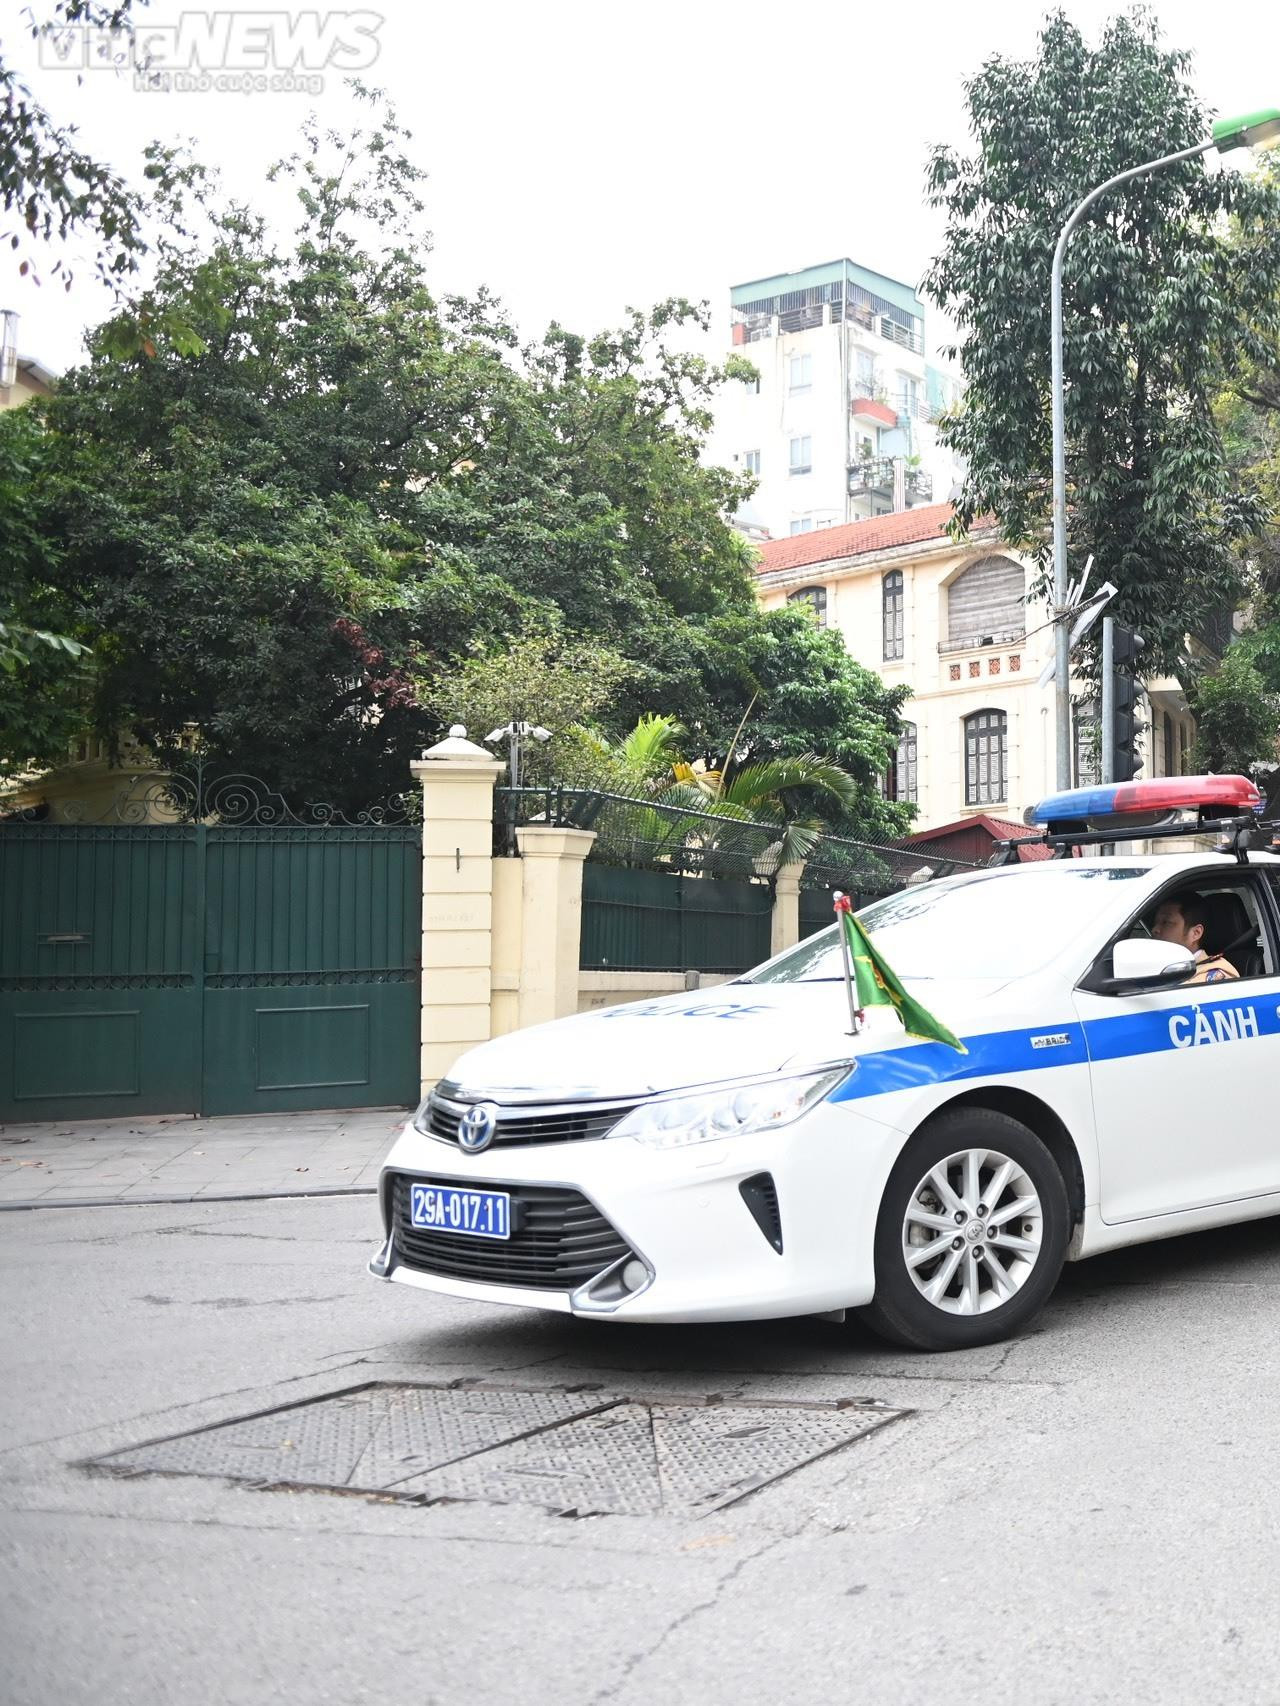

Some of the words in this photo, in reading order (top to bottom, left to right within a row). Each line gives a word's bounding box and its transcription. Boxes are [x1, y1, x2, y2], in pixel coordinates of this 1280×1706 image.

[588, 1003, 778, 1020] OLICE
[1168, 1004, 1259, 1049] CẢNH
[414, 1189, 505, 1233] 29A-017.11
